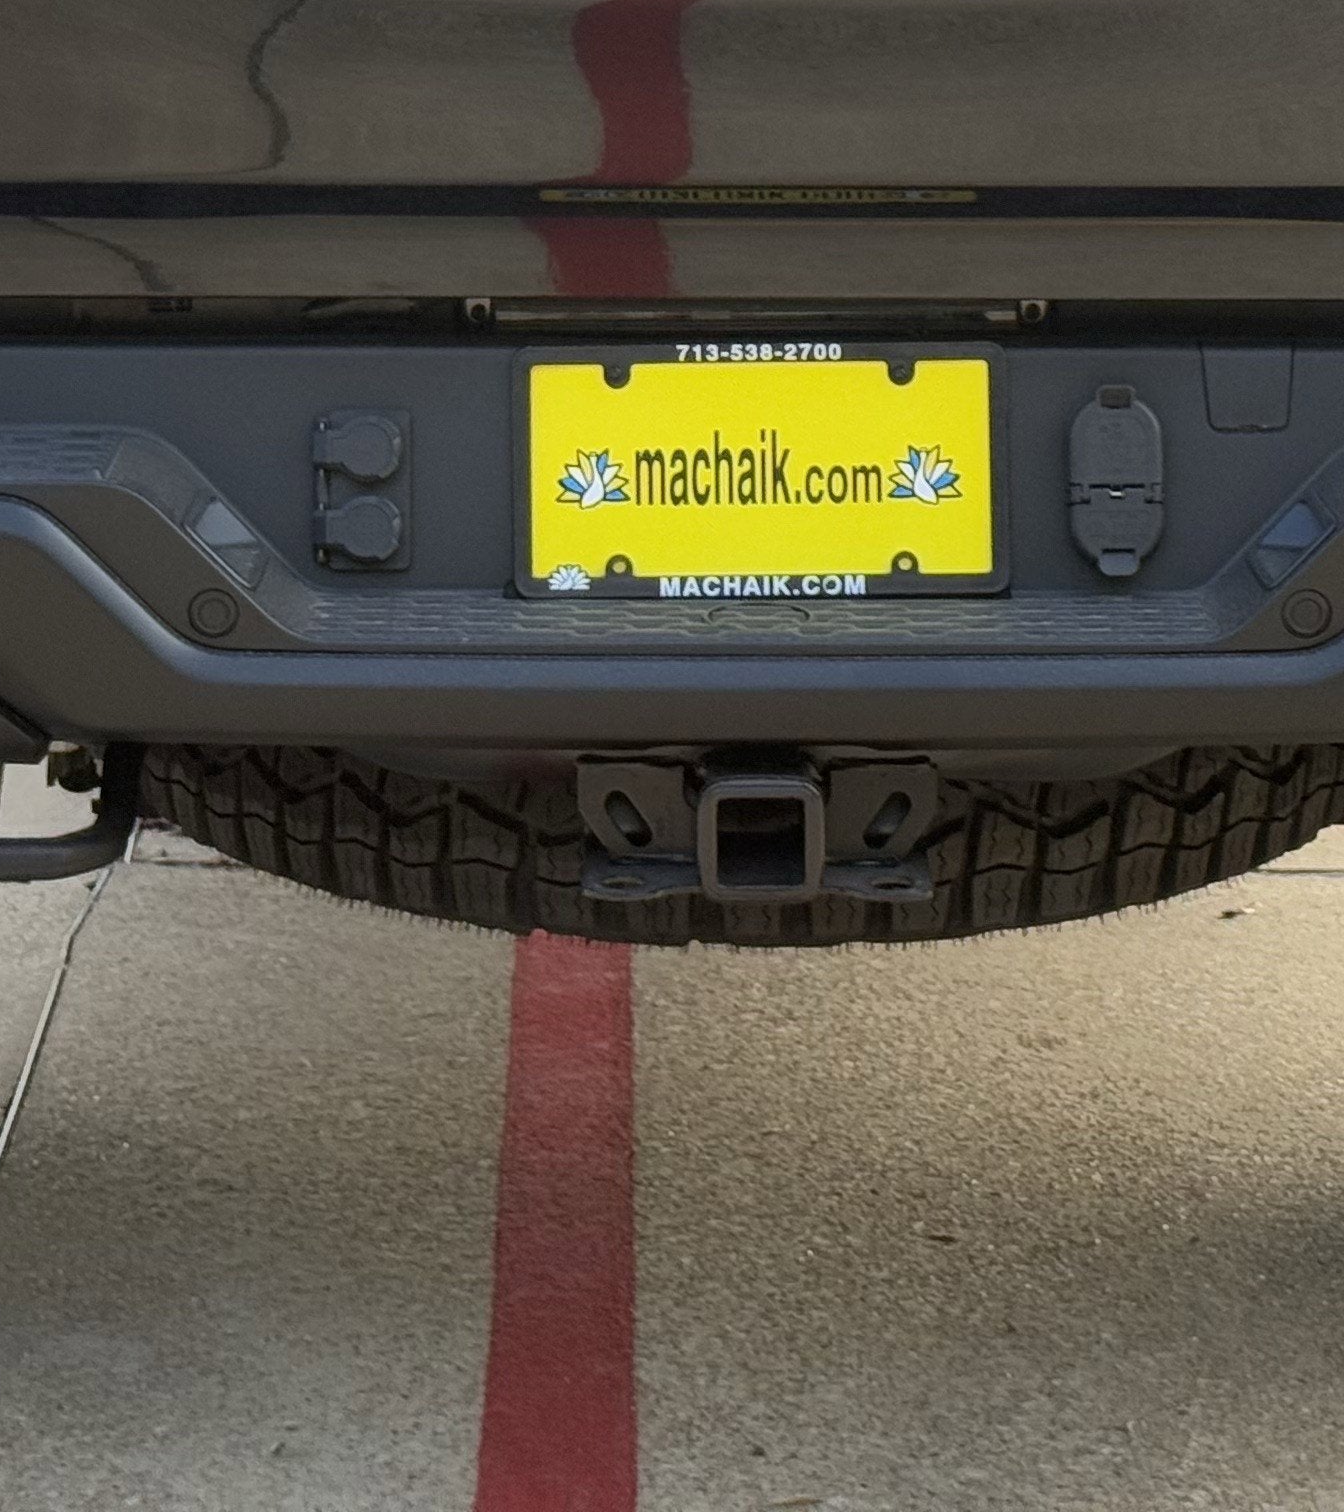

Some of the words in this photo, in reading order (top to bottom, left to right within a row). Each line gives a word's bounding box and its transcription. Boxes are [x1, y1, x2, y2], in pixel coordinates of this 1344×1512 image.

[676, 343, 843, 362] 713-538-2700
[634, 429, 883, 507] machaik.com
[658, 574, 867, 597] MACHAIK.COM
